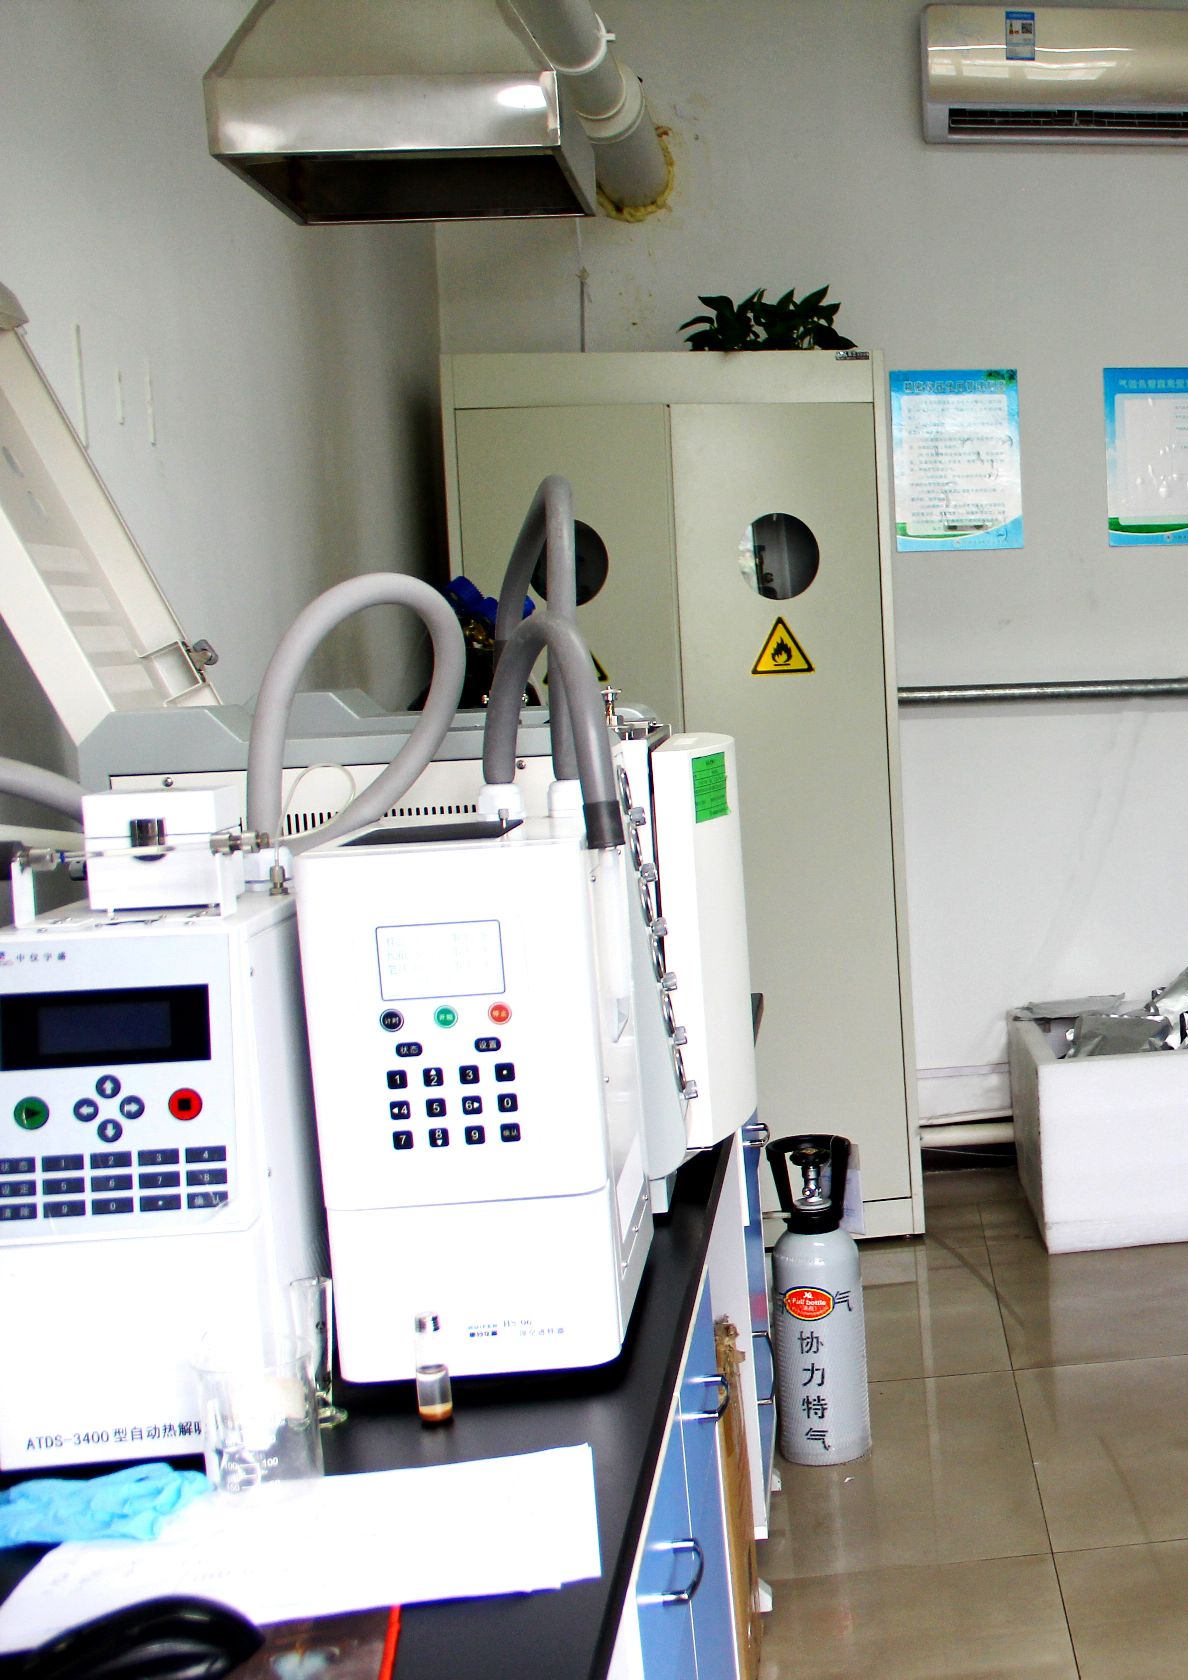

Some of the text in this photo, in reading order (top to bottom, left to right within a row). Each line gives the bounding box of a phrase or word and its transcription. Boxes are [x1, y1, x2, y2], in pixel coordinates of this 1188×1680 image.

[394, 1075, 400, 1085] 1
[430, 1075, 438, 1086] 2
[466, 1069, 473, 1081] 3
[432, 1102, 440, 1113] 5
[465, 1100, 473, 1111] 6
[504, 1097, 512, 1108] 0
[400, 1105, 408, 1115] 4
[435, 1128, 443, 1139] 8
[471, 1130, 479, 1140] 9
[399, 1135, 406, 1145] 7
[797, 1331, 831, 1451] 协力特气
[26, 1430, 110, 1451] ATDS-3400
[262, 1457, 279, 1468] 100
